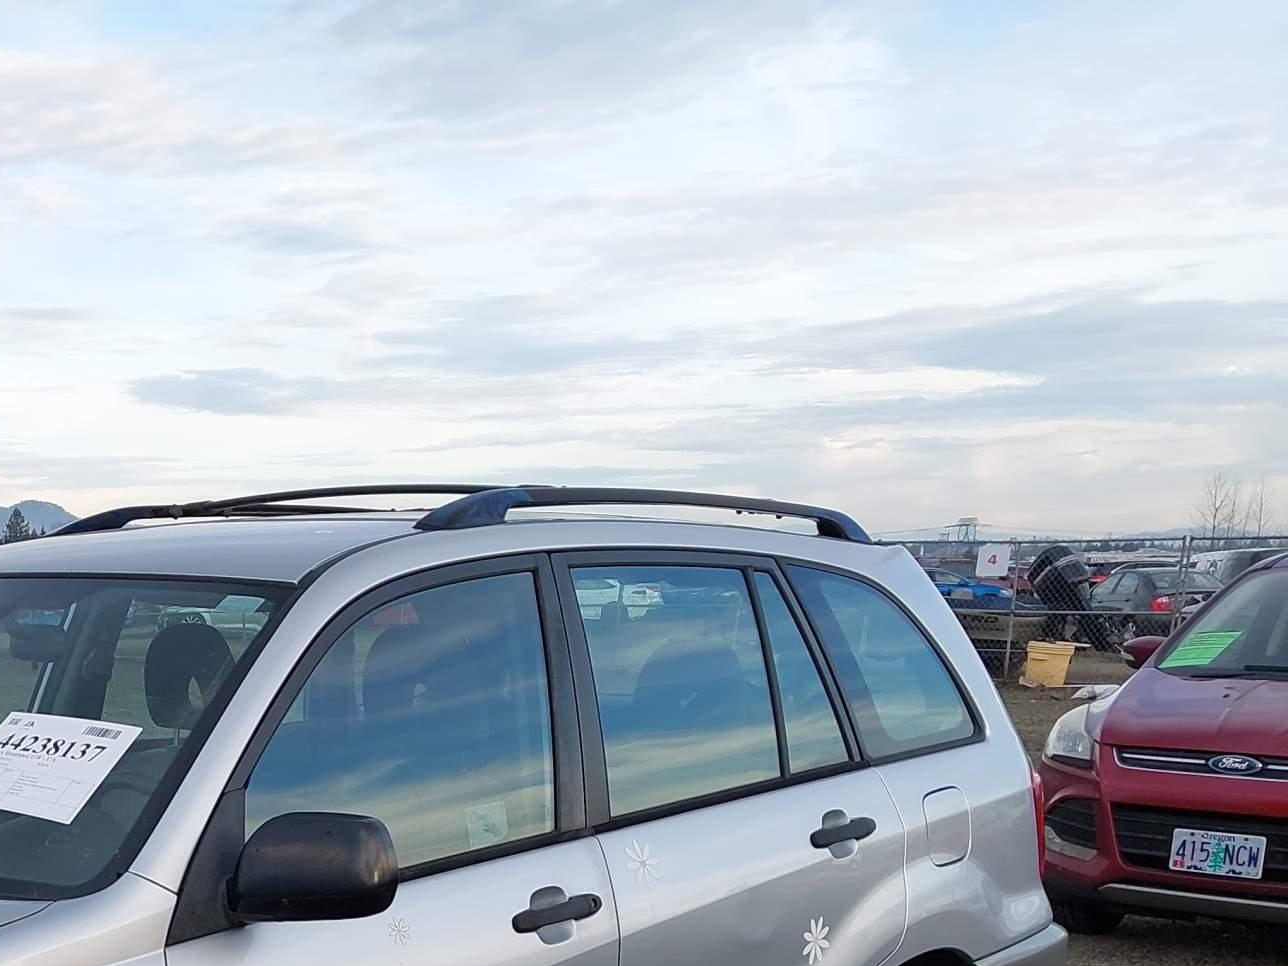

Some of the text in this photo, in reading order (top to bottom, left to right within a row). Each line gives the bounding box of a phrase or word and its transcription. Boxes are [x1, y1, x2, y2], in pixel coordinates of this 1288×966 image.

[987, 554, 997, 565] 4
[1218, 757, 1250, 770] Ford
[1201, 832, 1236, 842] Oregon
[1175, 839, 1260, 867] 415 NCW
